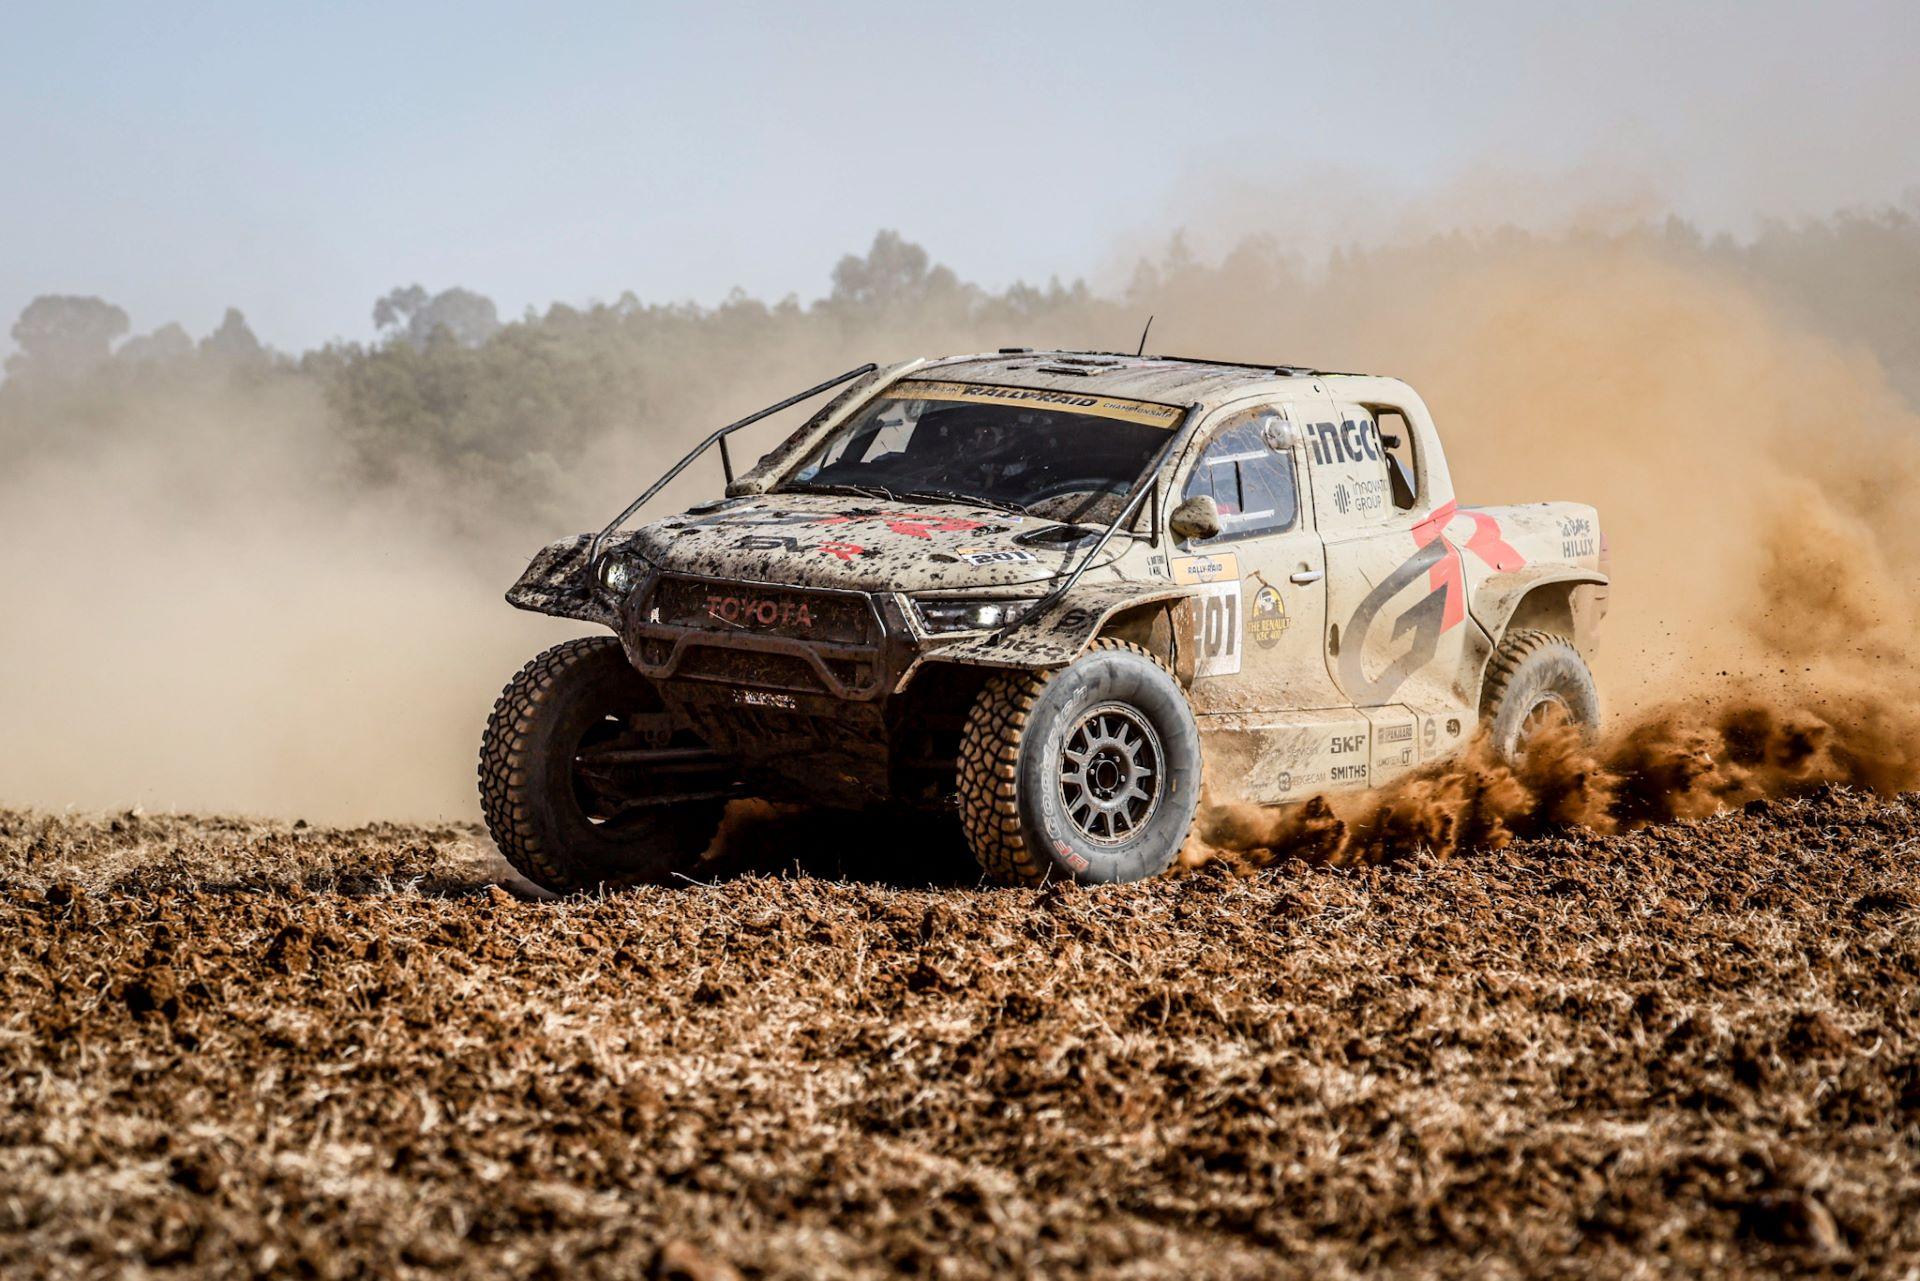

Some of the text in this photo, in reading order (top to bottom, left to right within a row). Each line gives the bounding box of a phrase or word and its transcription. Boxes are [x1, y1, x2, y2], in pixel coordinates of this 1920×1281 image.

[1103, 403, 1172, 418] CHAMPIONSHIP
[1355, 495, 1381, 511] GROUP
[1562, 538, 1594, 558] HILUX
[972, 551, 1030, 565] 201
[1187, 563, 1222, 575] RALLY-RAID
[705, 596, 813, 628] TOYOTA
[1330, 735, 1366, 753] SKF
[1330, 764, 1367, 780] SMITHS
